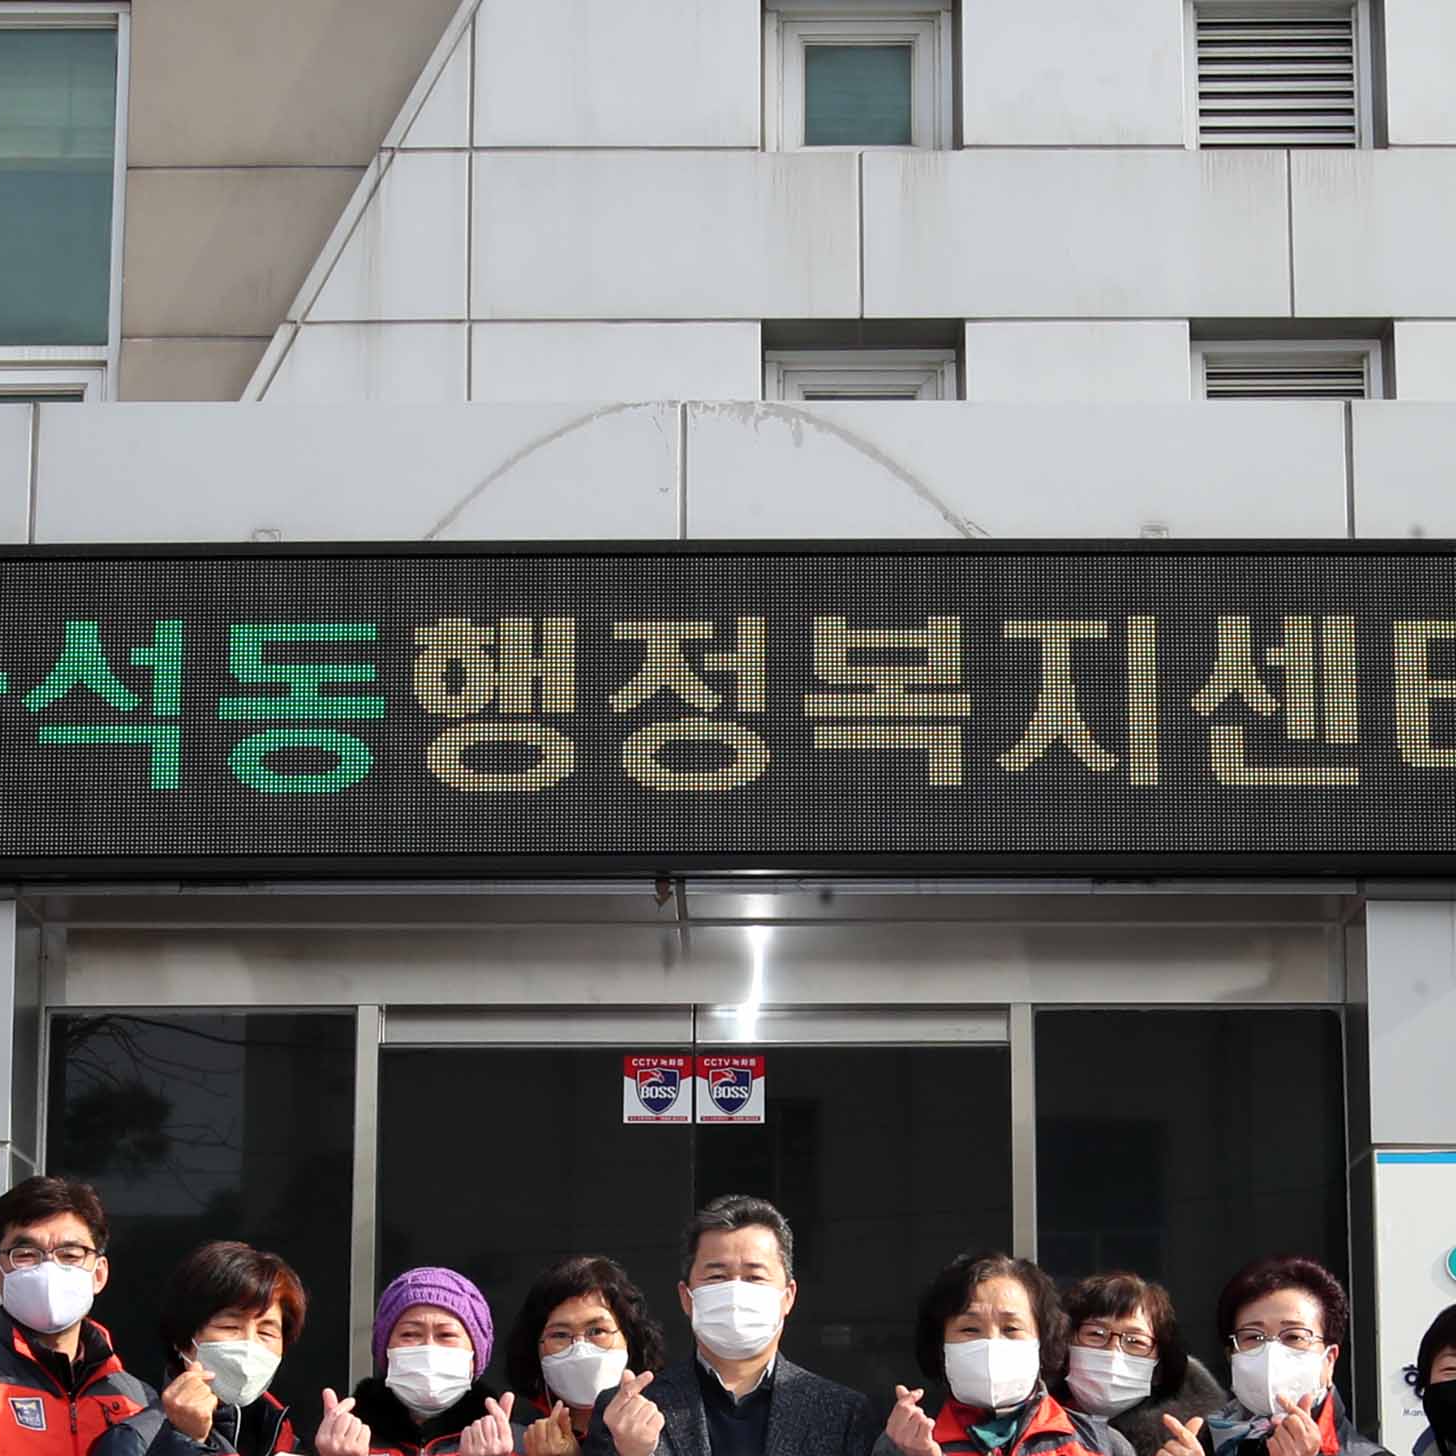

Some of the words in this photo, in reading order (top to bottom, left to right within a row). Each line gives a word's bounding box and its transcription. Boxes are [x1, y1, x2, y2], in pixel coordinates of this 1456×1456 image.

[632, 1058, 658, 1066] CCTV
[704, 1058, 730, 1066] CCTV
[641, 1086, 676, 1099] BOSS
[713, 1086, 748, 1099] BOSS
